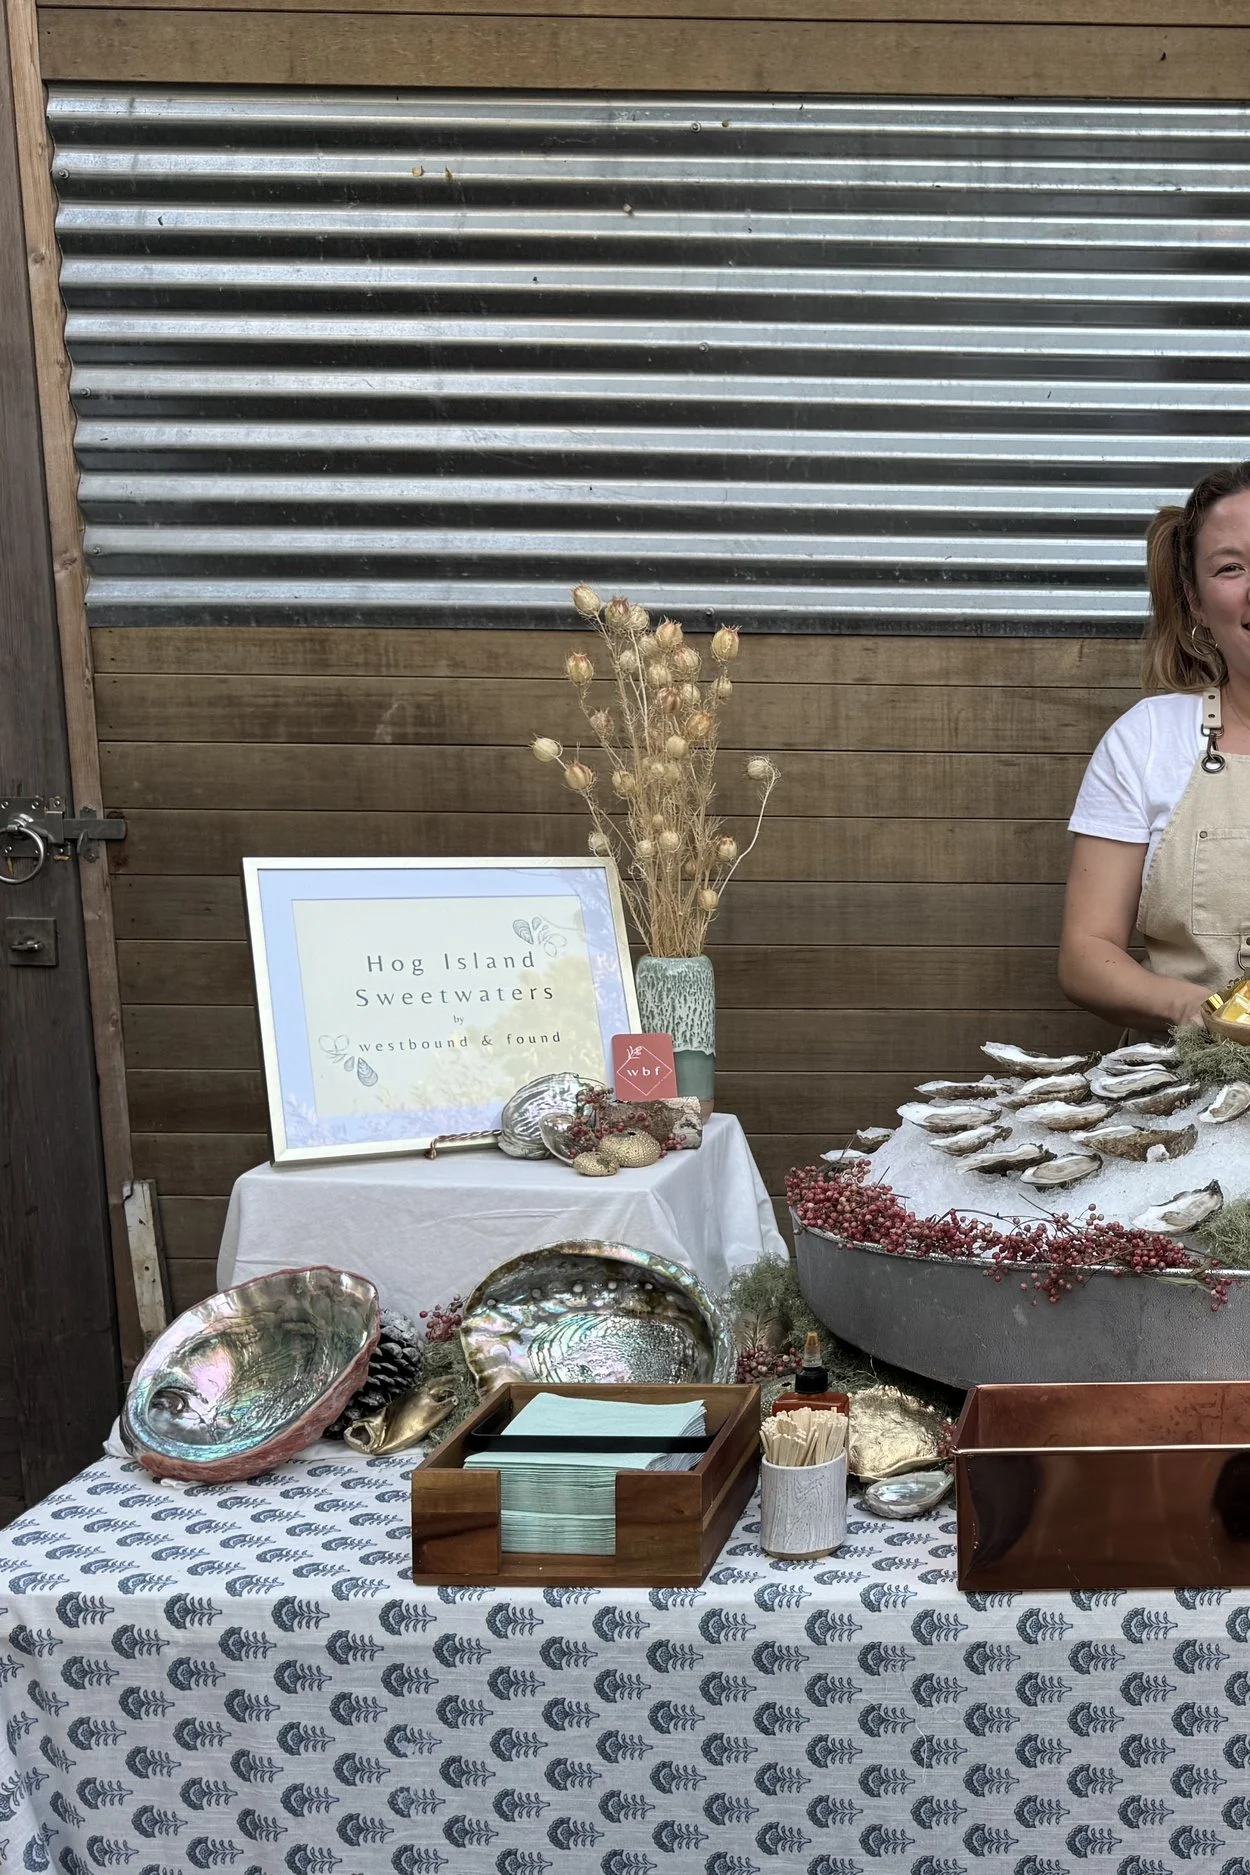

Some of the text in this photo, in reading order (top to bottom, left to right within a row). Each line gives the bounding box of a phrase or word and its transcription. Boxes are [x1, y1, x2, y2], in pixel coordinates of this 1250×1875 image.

[366, 950, 536, 977] Hog Island
[355, 984, 555, 1008] Sweetwaters
[452, 1013, 465, 1026] by
[359, 1030, 562, 1053] westbound & found
